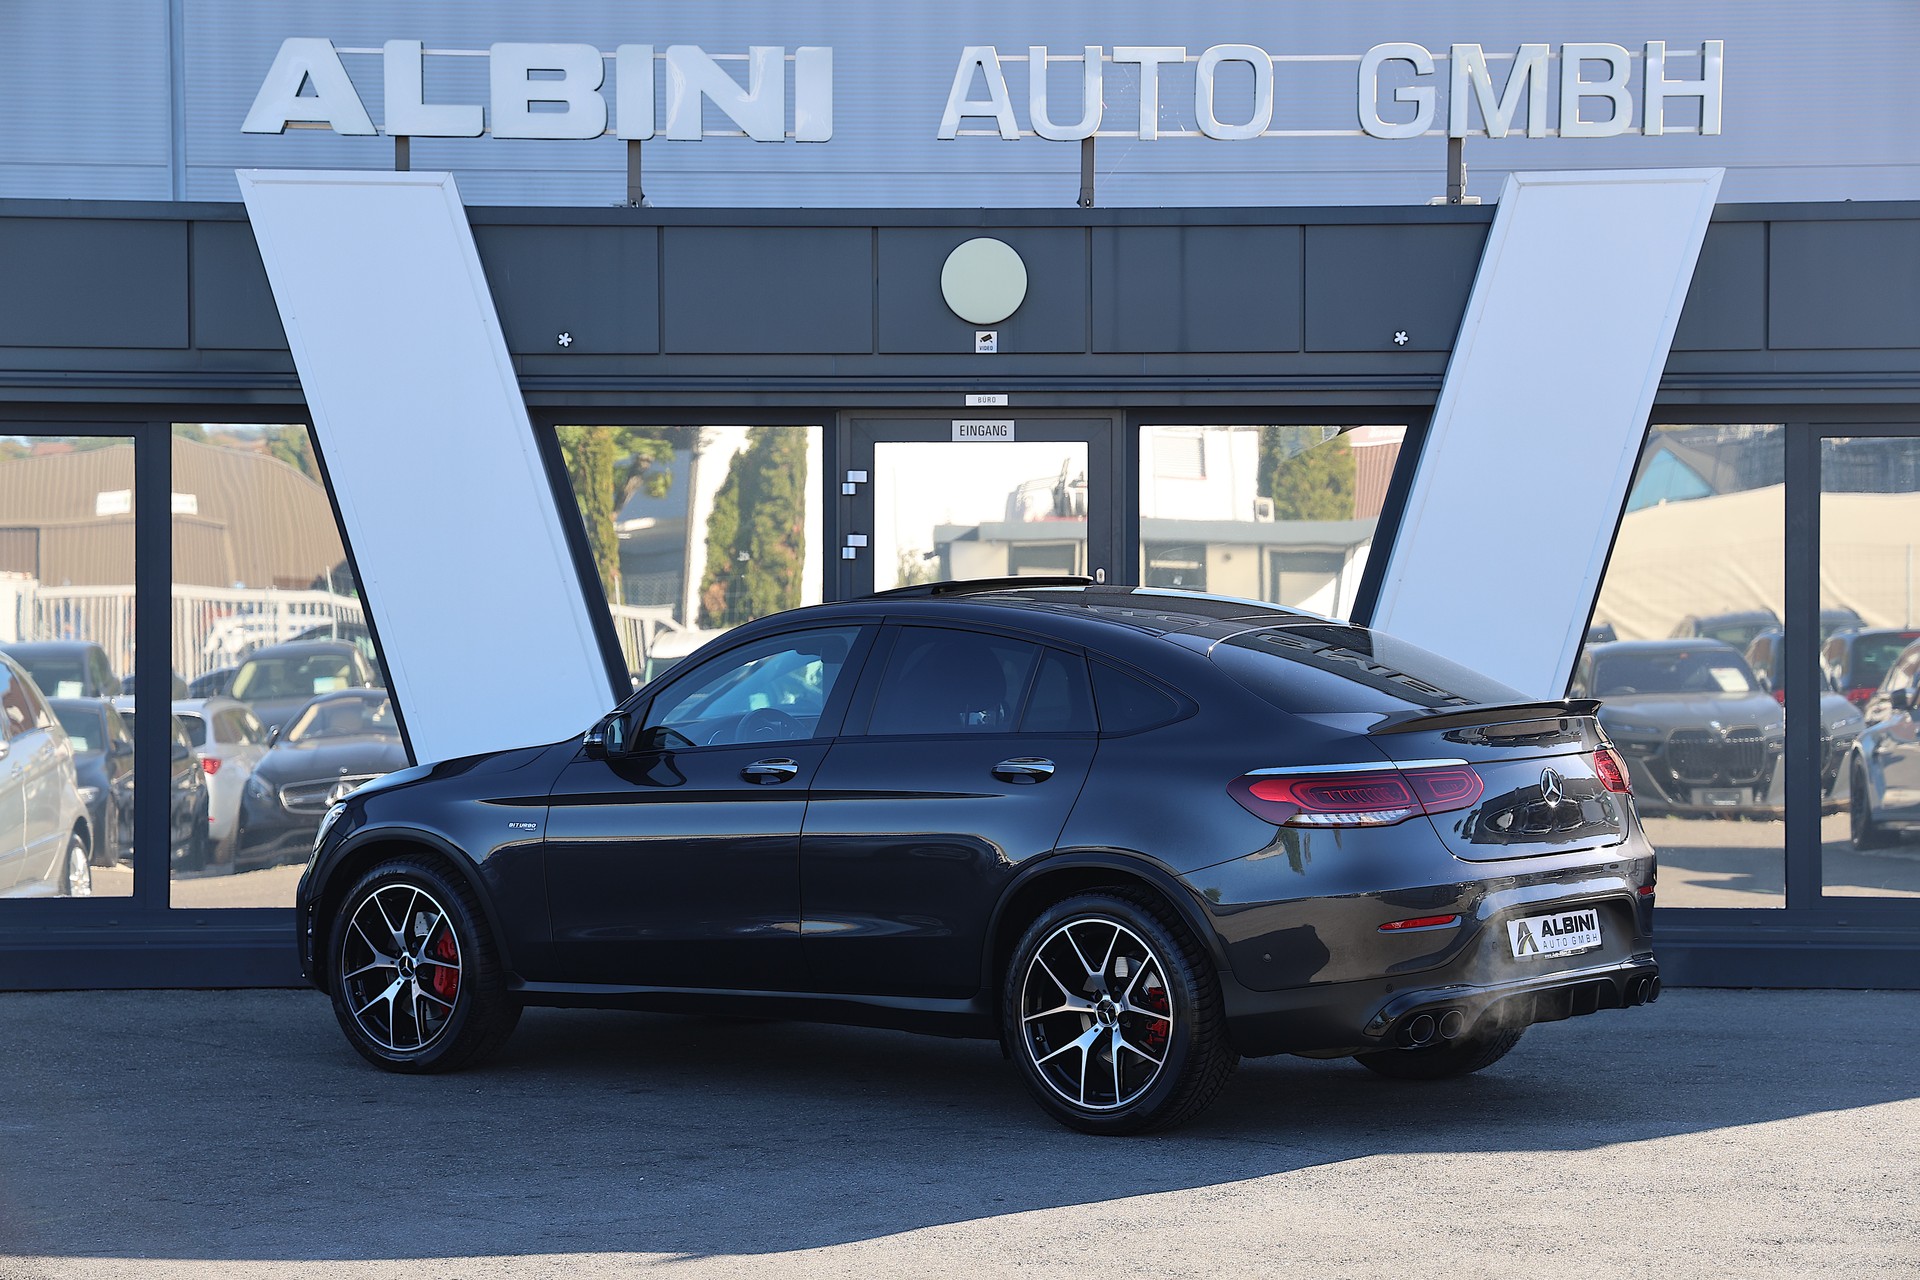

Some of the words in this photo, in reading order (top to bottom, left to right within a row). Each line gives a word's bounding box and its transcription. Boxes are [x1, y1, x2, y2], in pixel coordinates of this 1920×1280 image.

[241, 37, 833, 142] ALBINI
[937, 43, 1273, 141] AUTO
[1358, 39, 1725, 139] GMBH
[960, 425, 1007, 436] EINGANG
[1541, 913, 1596, 938] ALBINI
[1543, 937, 1568, 950] AUTO
[1571, 933, 1598, 945] GMBH
